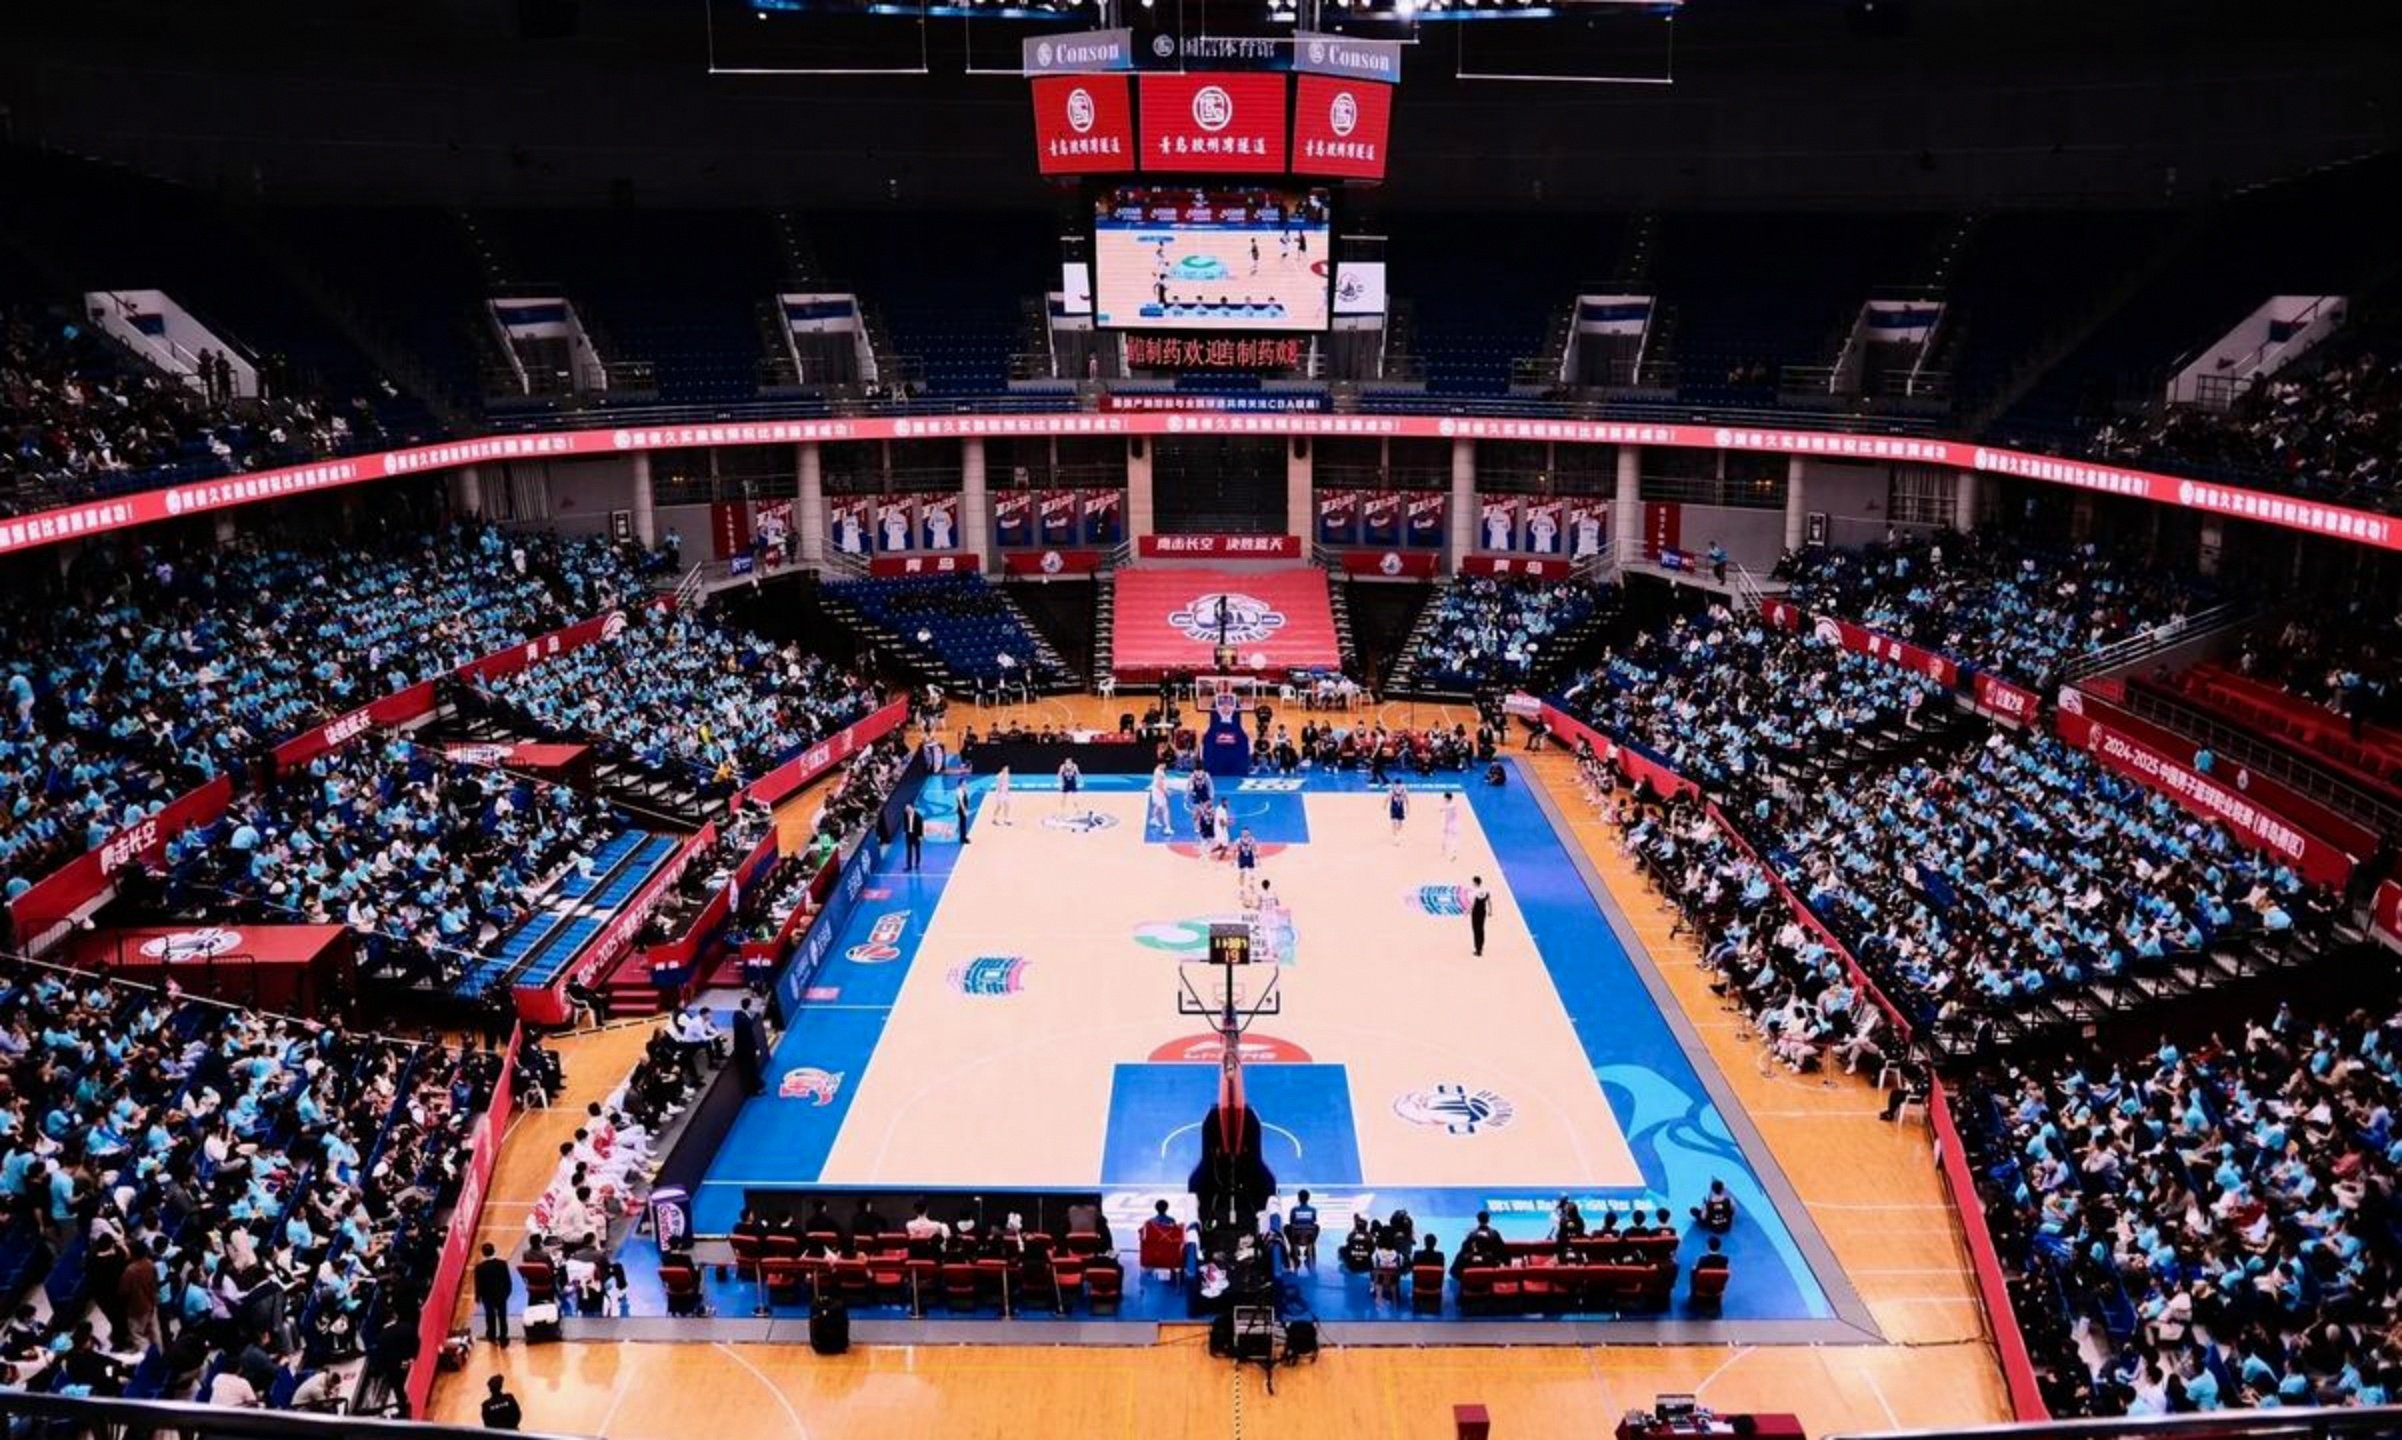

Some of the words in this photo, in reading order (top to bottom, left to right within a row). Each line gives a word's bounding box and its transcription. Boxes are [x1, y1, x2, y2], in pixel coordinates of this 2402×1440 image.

[1056, 42, 1119, 64] Conson
[1329, 44, 1390, 71] Conson
[1156, 537, 1215, 551] 鹰击长空
[1225, 537, 1284, 551] 决胜蓝天
[2104, 735, 2160, 776] 2024-2025
